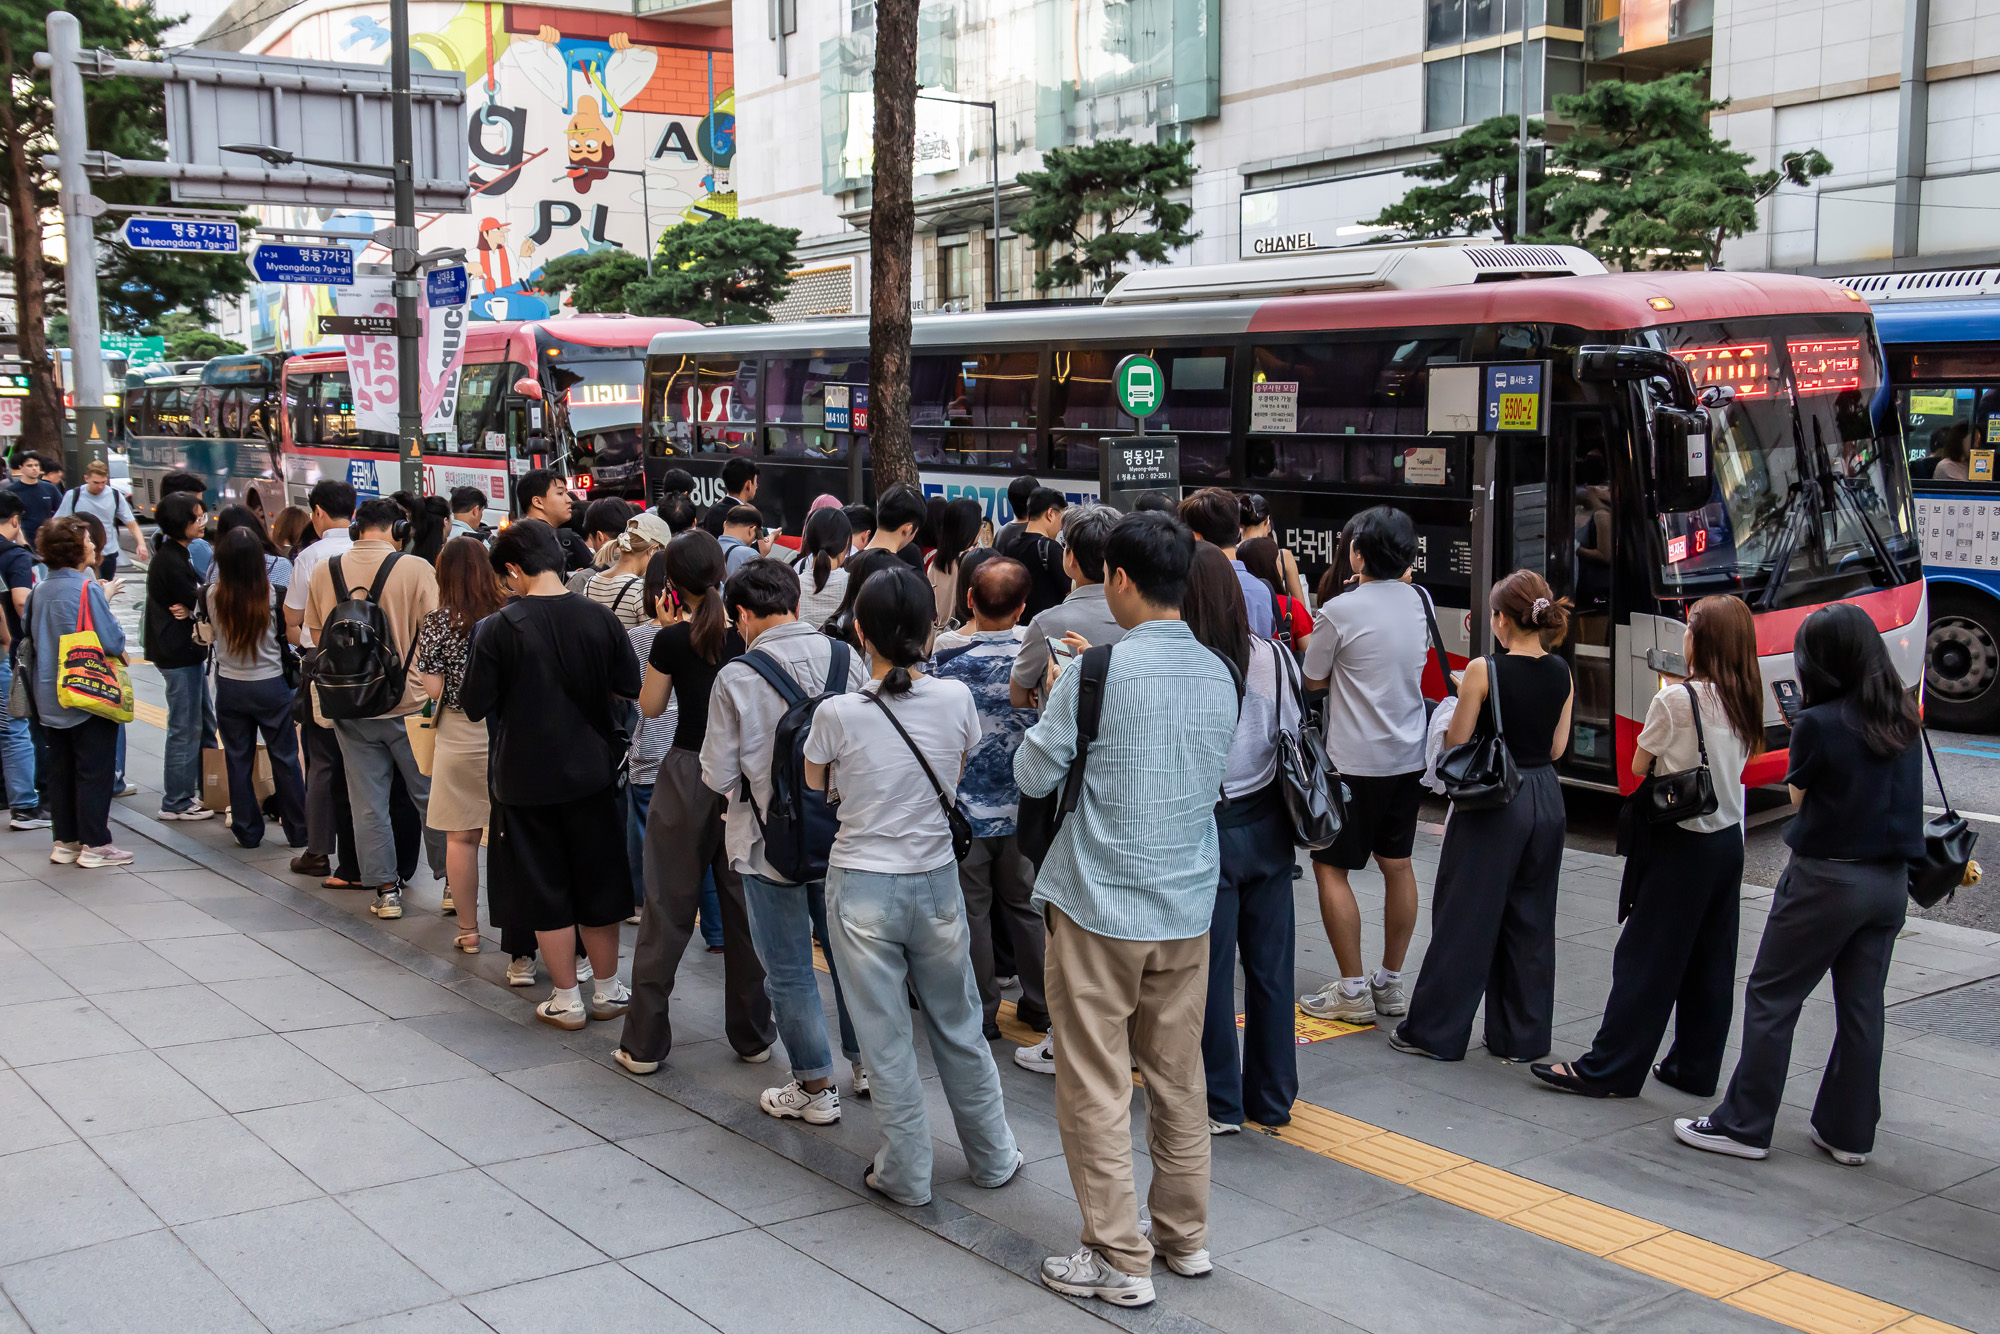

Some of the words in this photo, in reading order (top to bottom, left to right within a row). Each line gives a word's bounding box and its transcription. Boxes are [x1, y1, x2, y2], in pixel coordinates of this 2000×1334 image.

[171, 223, 234, 240] 명동7가길
[141, 236, 201, 248] Myeongdong
[203, 239, 235, 250] 7ga-gil
[1254, 232, 1316, 254] CHANEL
[299, 249, 351, 264] 명동7가길
[266, 262, 321, 274] Myeongdong
[322, 264, 351, 275] 7ga-gil
[1256, 384, 1281, 393] 승무사원
[1283, 384, 1296, 393] 모집
[1281, 395, 1292, 403] 가능
[1505, 397, 1533, 420] 5500-2
[826, 412, 848, 424] M4101
[1123, 449, 1165, 466] 명동입구
[351, 460, 378, 491] 공공버스
[577, 475, 591, 488] 19
[690, 476, 726, 508] BUS
[1286, 528, 1333, 565] 단국대
[101, 684, 107, 692] A
